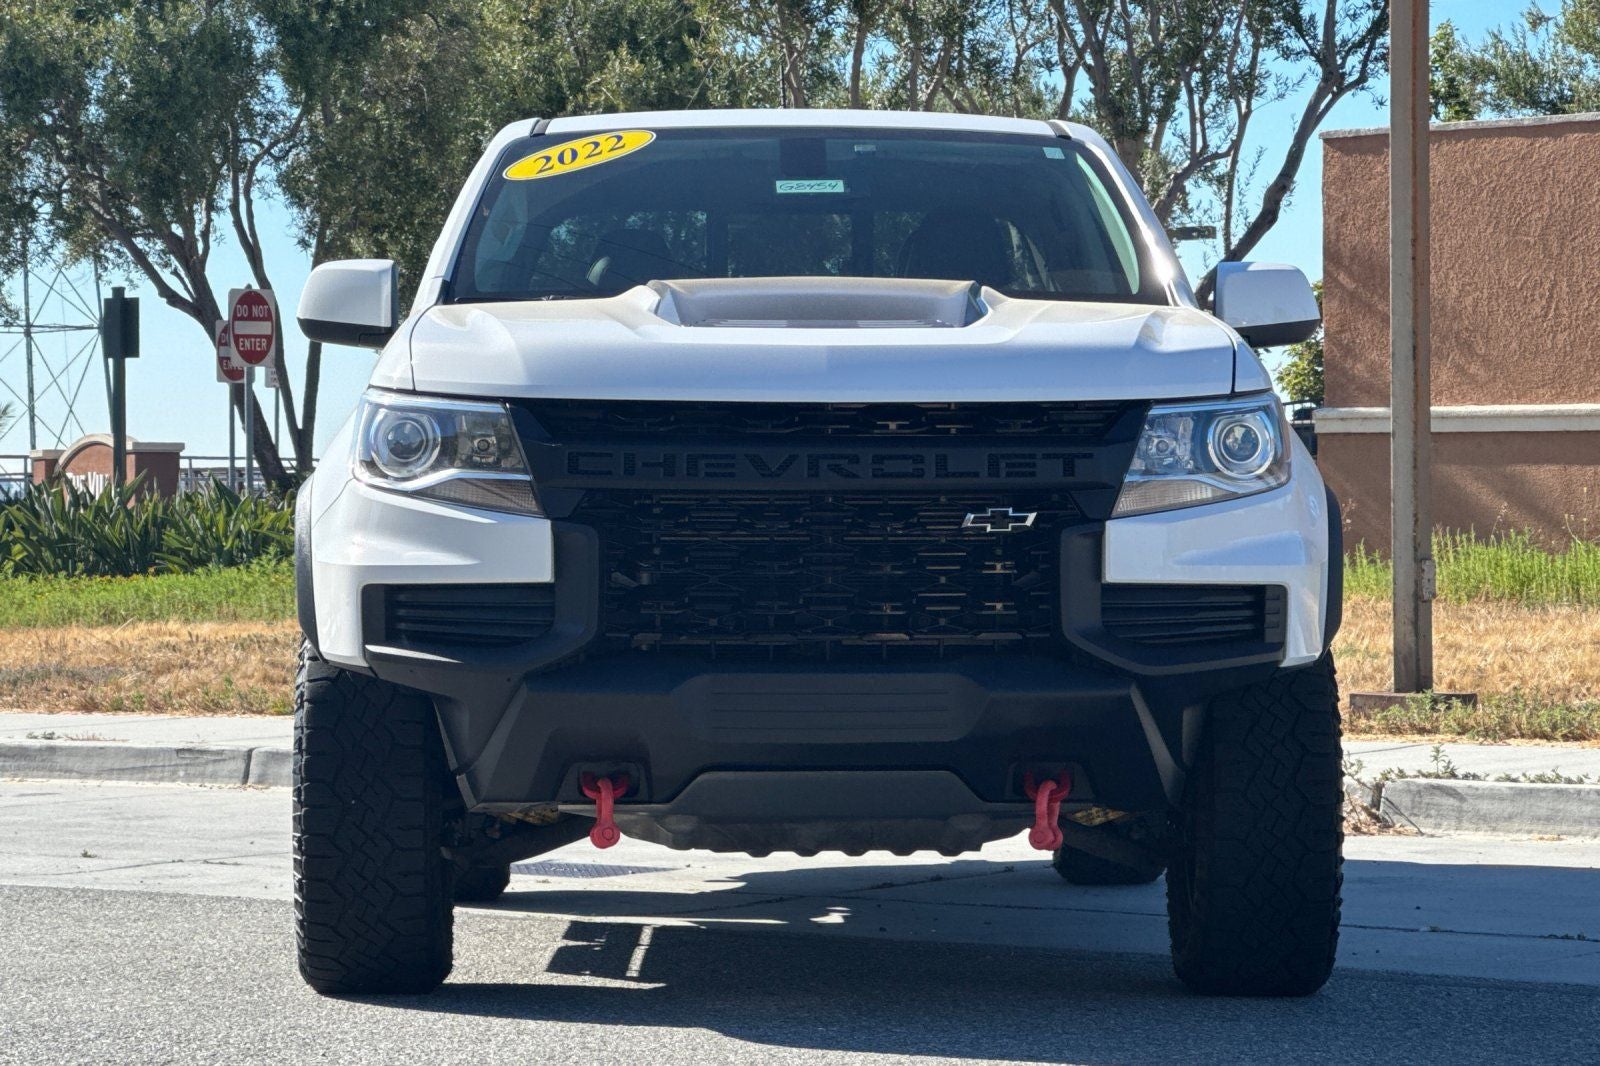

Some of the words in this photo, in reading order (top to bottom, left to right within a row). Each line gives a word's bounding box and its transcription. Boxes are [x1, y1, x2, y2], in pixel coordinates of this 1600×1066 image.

[533, 134, 626, 175] 2022
[236, 305, 248, 317] DO
[252, 305, 268, 317] NOT
[239, 338, 267, 351] ENTER
[566, 452, 1094, 478] CHEVROLET
